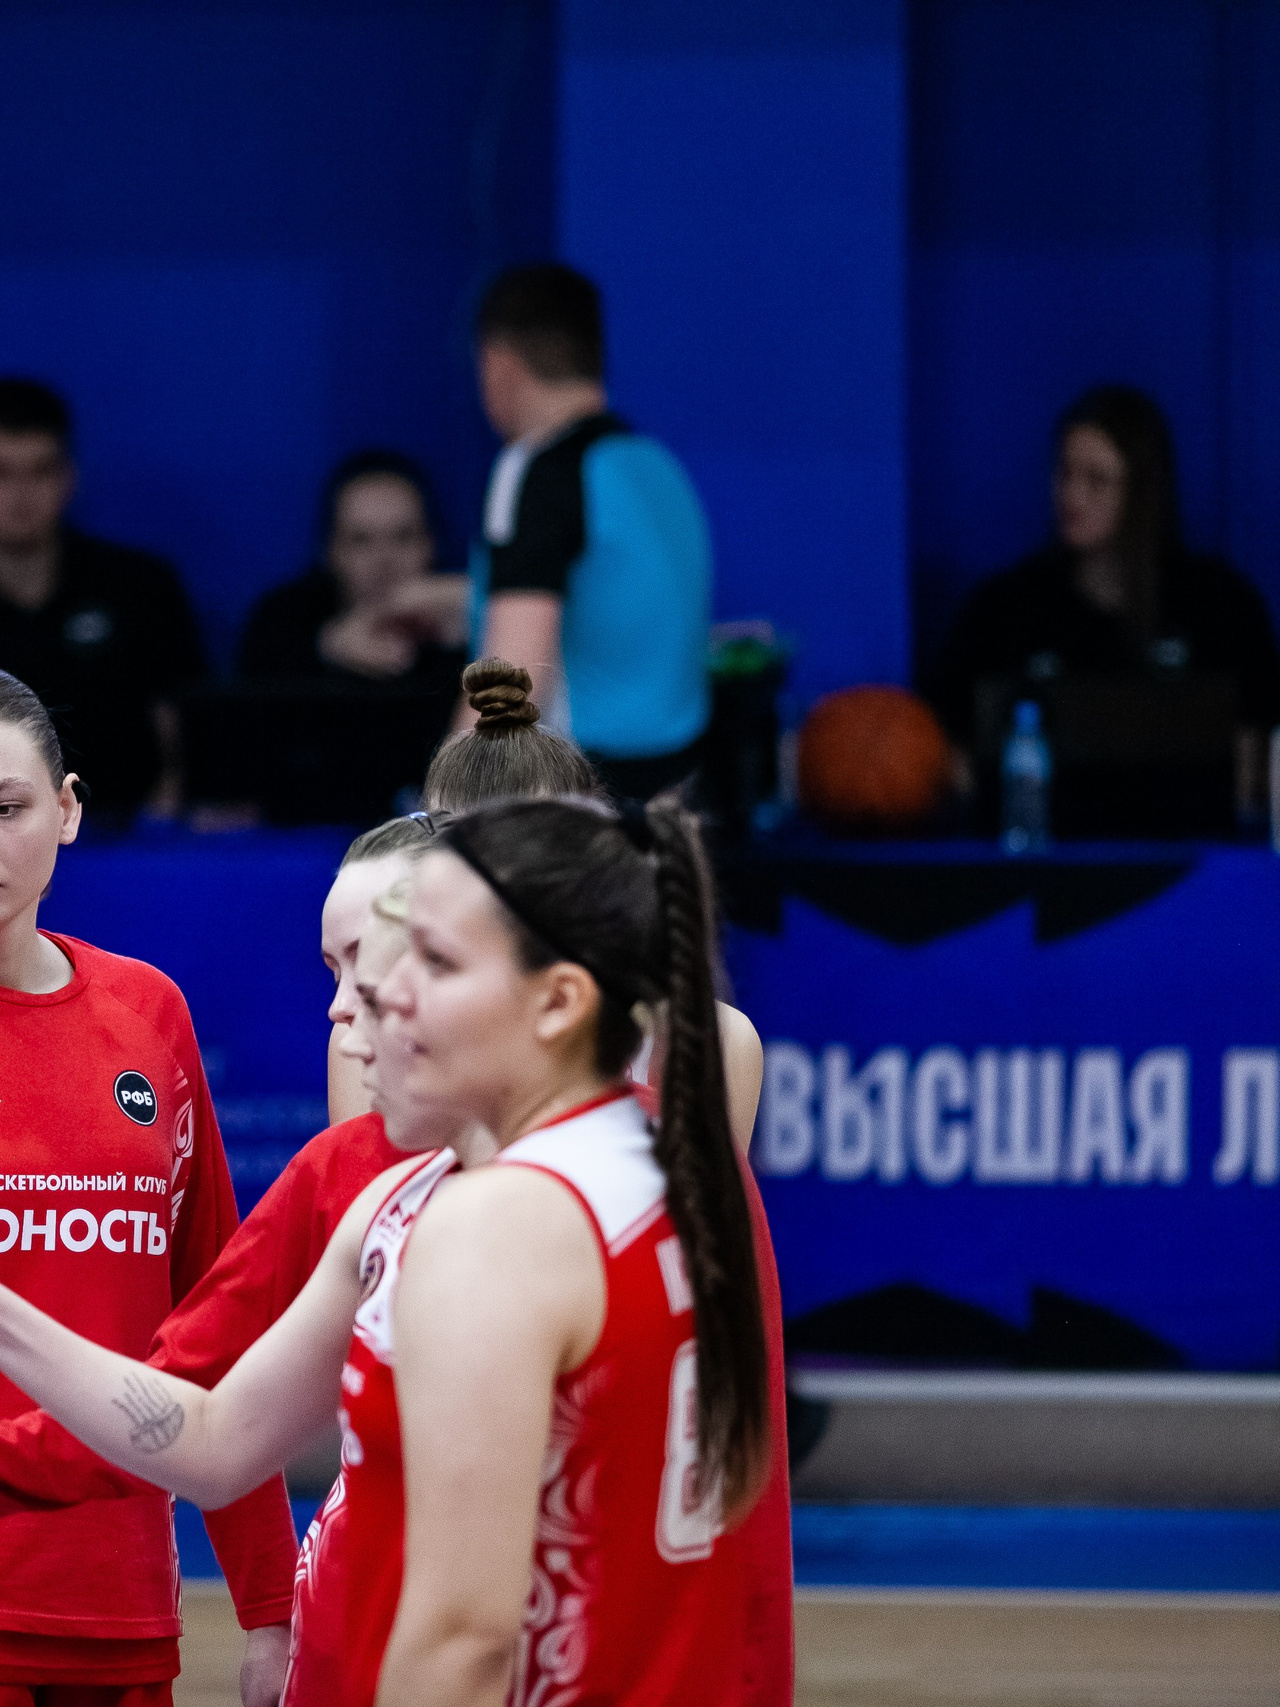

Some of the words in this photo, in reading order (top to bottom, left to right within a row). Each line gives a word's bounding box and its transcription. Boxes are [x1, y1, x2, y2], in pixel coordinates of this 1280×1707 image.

[120, 1090, 153, 1106] РФБ
[756, 1037, 1190, 1186] ВЫСШАЯ
[134, 1176, 167, 1196] КЛУБ
